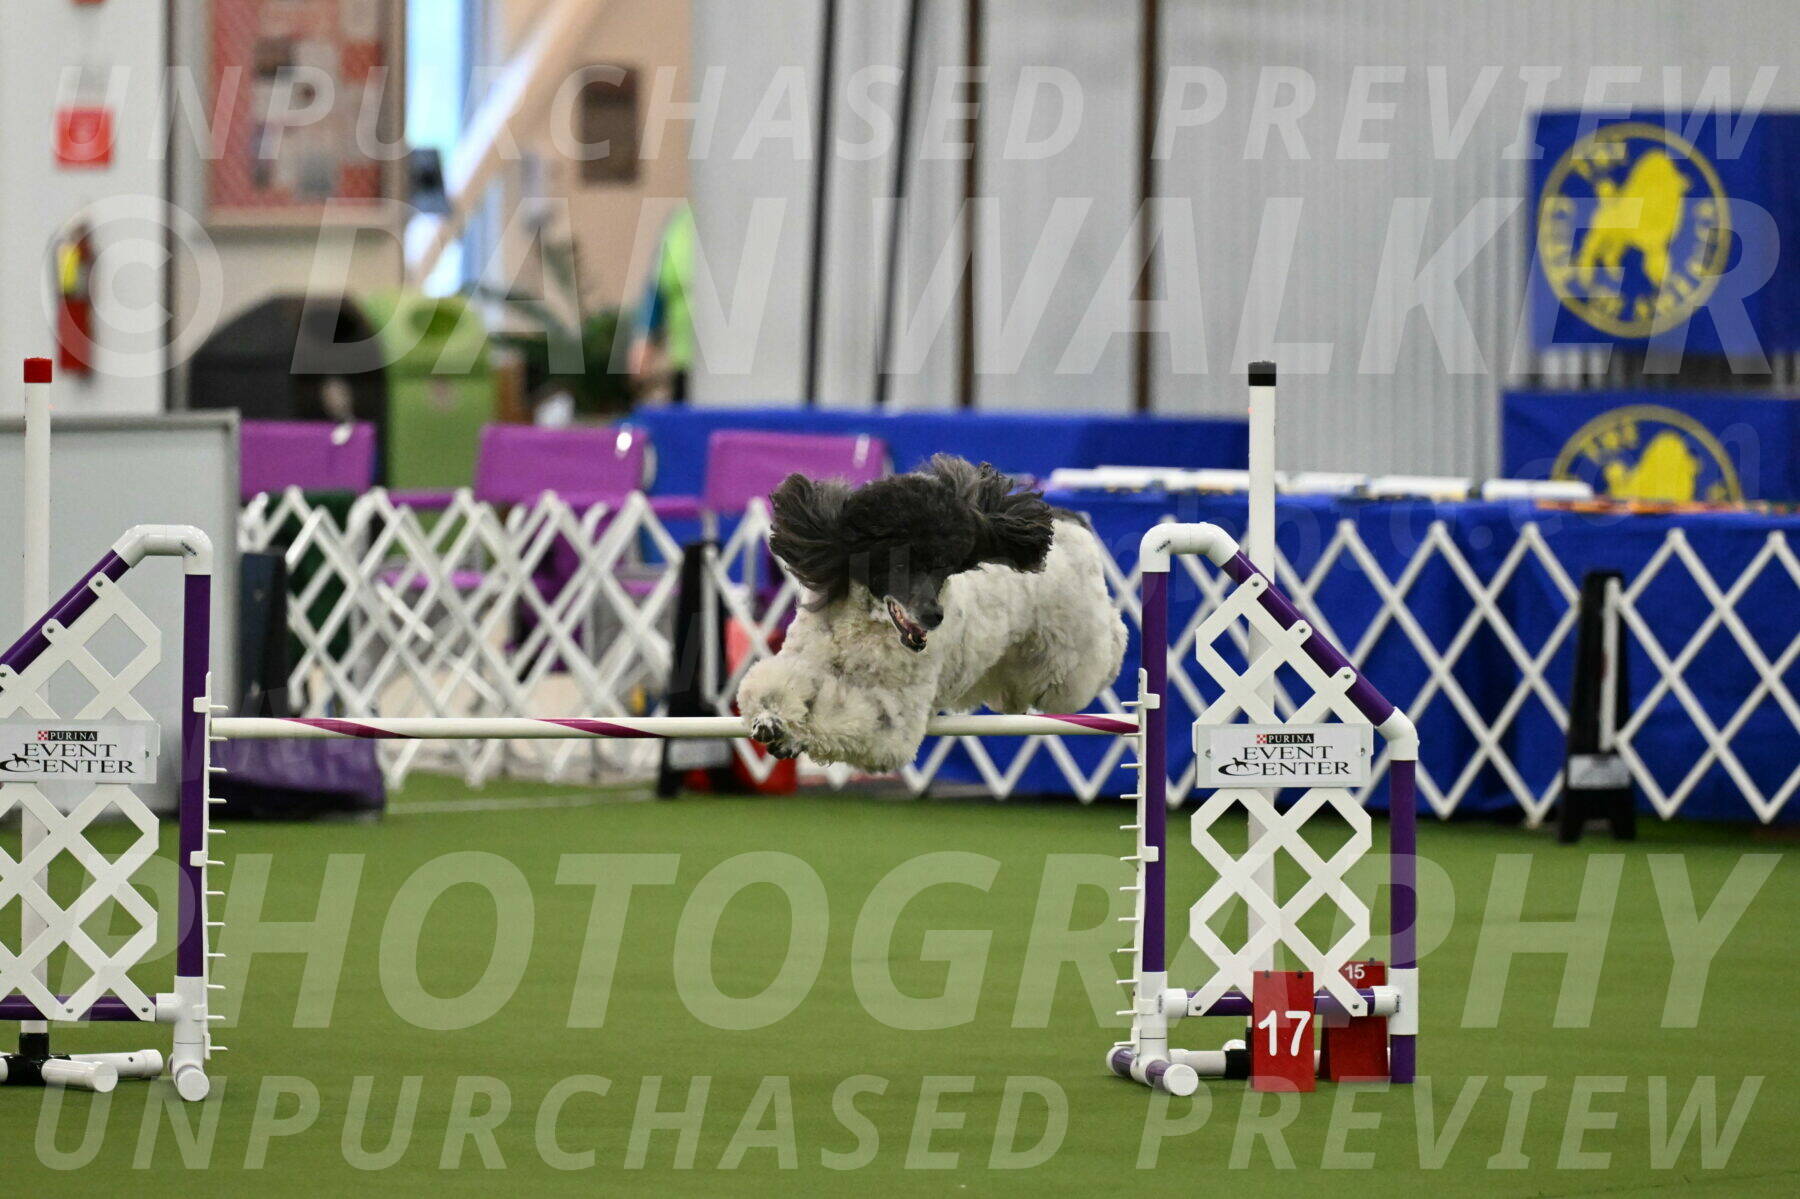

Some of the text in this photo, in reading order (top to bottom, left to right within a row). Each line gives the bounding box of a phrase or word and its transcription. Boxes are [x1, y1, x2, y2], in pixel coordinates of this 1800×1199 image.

[50, 731, 96, 741] PURINA
[1268, 734, 1314, 744] PURINA
[24, 743, 118, 758] EVENT
[1242, 745, 1334, 761] EVENT
[0, 758, 136, 774] CENTER
[1217, 761, 1352, 777] CENTER
[1344, 963, 1366, 980] 15
[1258, 1009, 1312, 1057] 17
